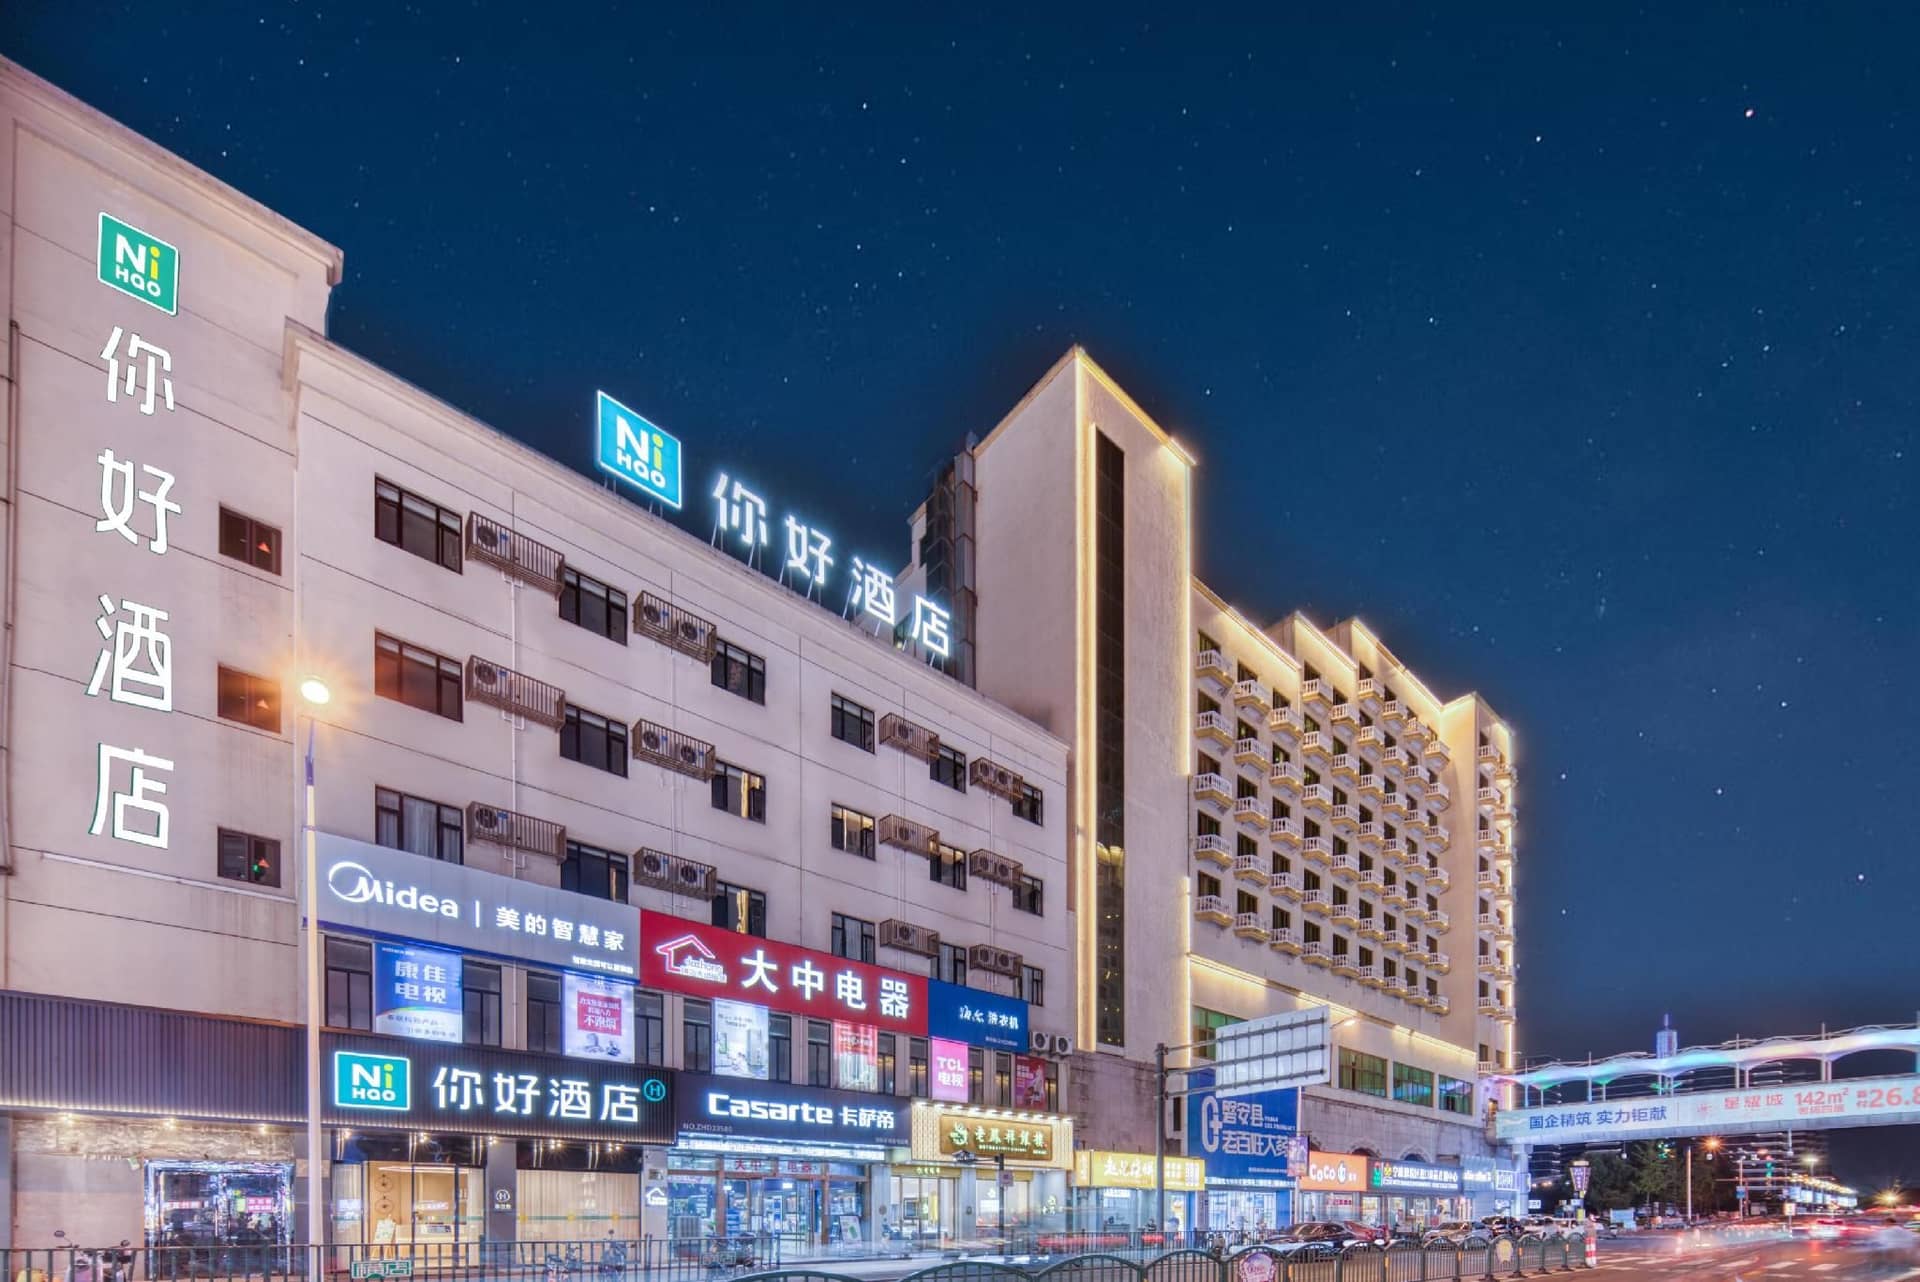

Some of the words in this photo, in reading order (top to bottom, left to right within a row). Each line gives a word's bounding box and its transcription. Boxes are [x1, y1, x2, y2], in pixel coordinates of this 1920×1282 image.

[115, 231, 161, 280] Ni
[616, 414, 664, 472] Ni
[86, 324, 183, 850] 你好酒店
[712, 471, 951, 660] 你好酒店
[345, 870, 459, 919] Midea
[496, 905, 625, 951] 美的智慧家
[394, 982, 448, 1005] 电视
[741, 949, 909, 1019] 大中电器
[351, 1063, 394, 1089] Ni
[936, 1056, 965, 1072] TCL
[937, 1071, 964, 1088] 电视
[433, 1067, 641, 1123] 你好酒店
[708, 1092, 833, 1124] Casarte
[839, 1105, 895, 1130] 卡萨帝
[1529, 1111, 1592, 1129] 国企精筑
[1596, 1105, 1668, 1125] 实力钜献
